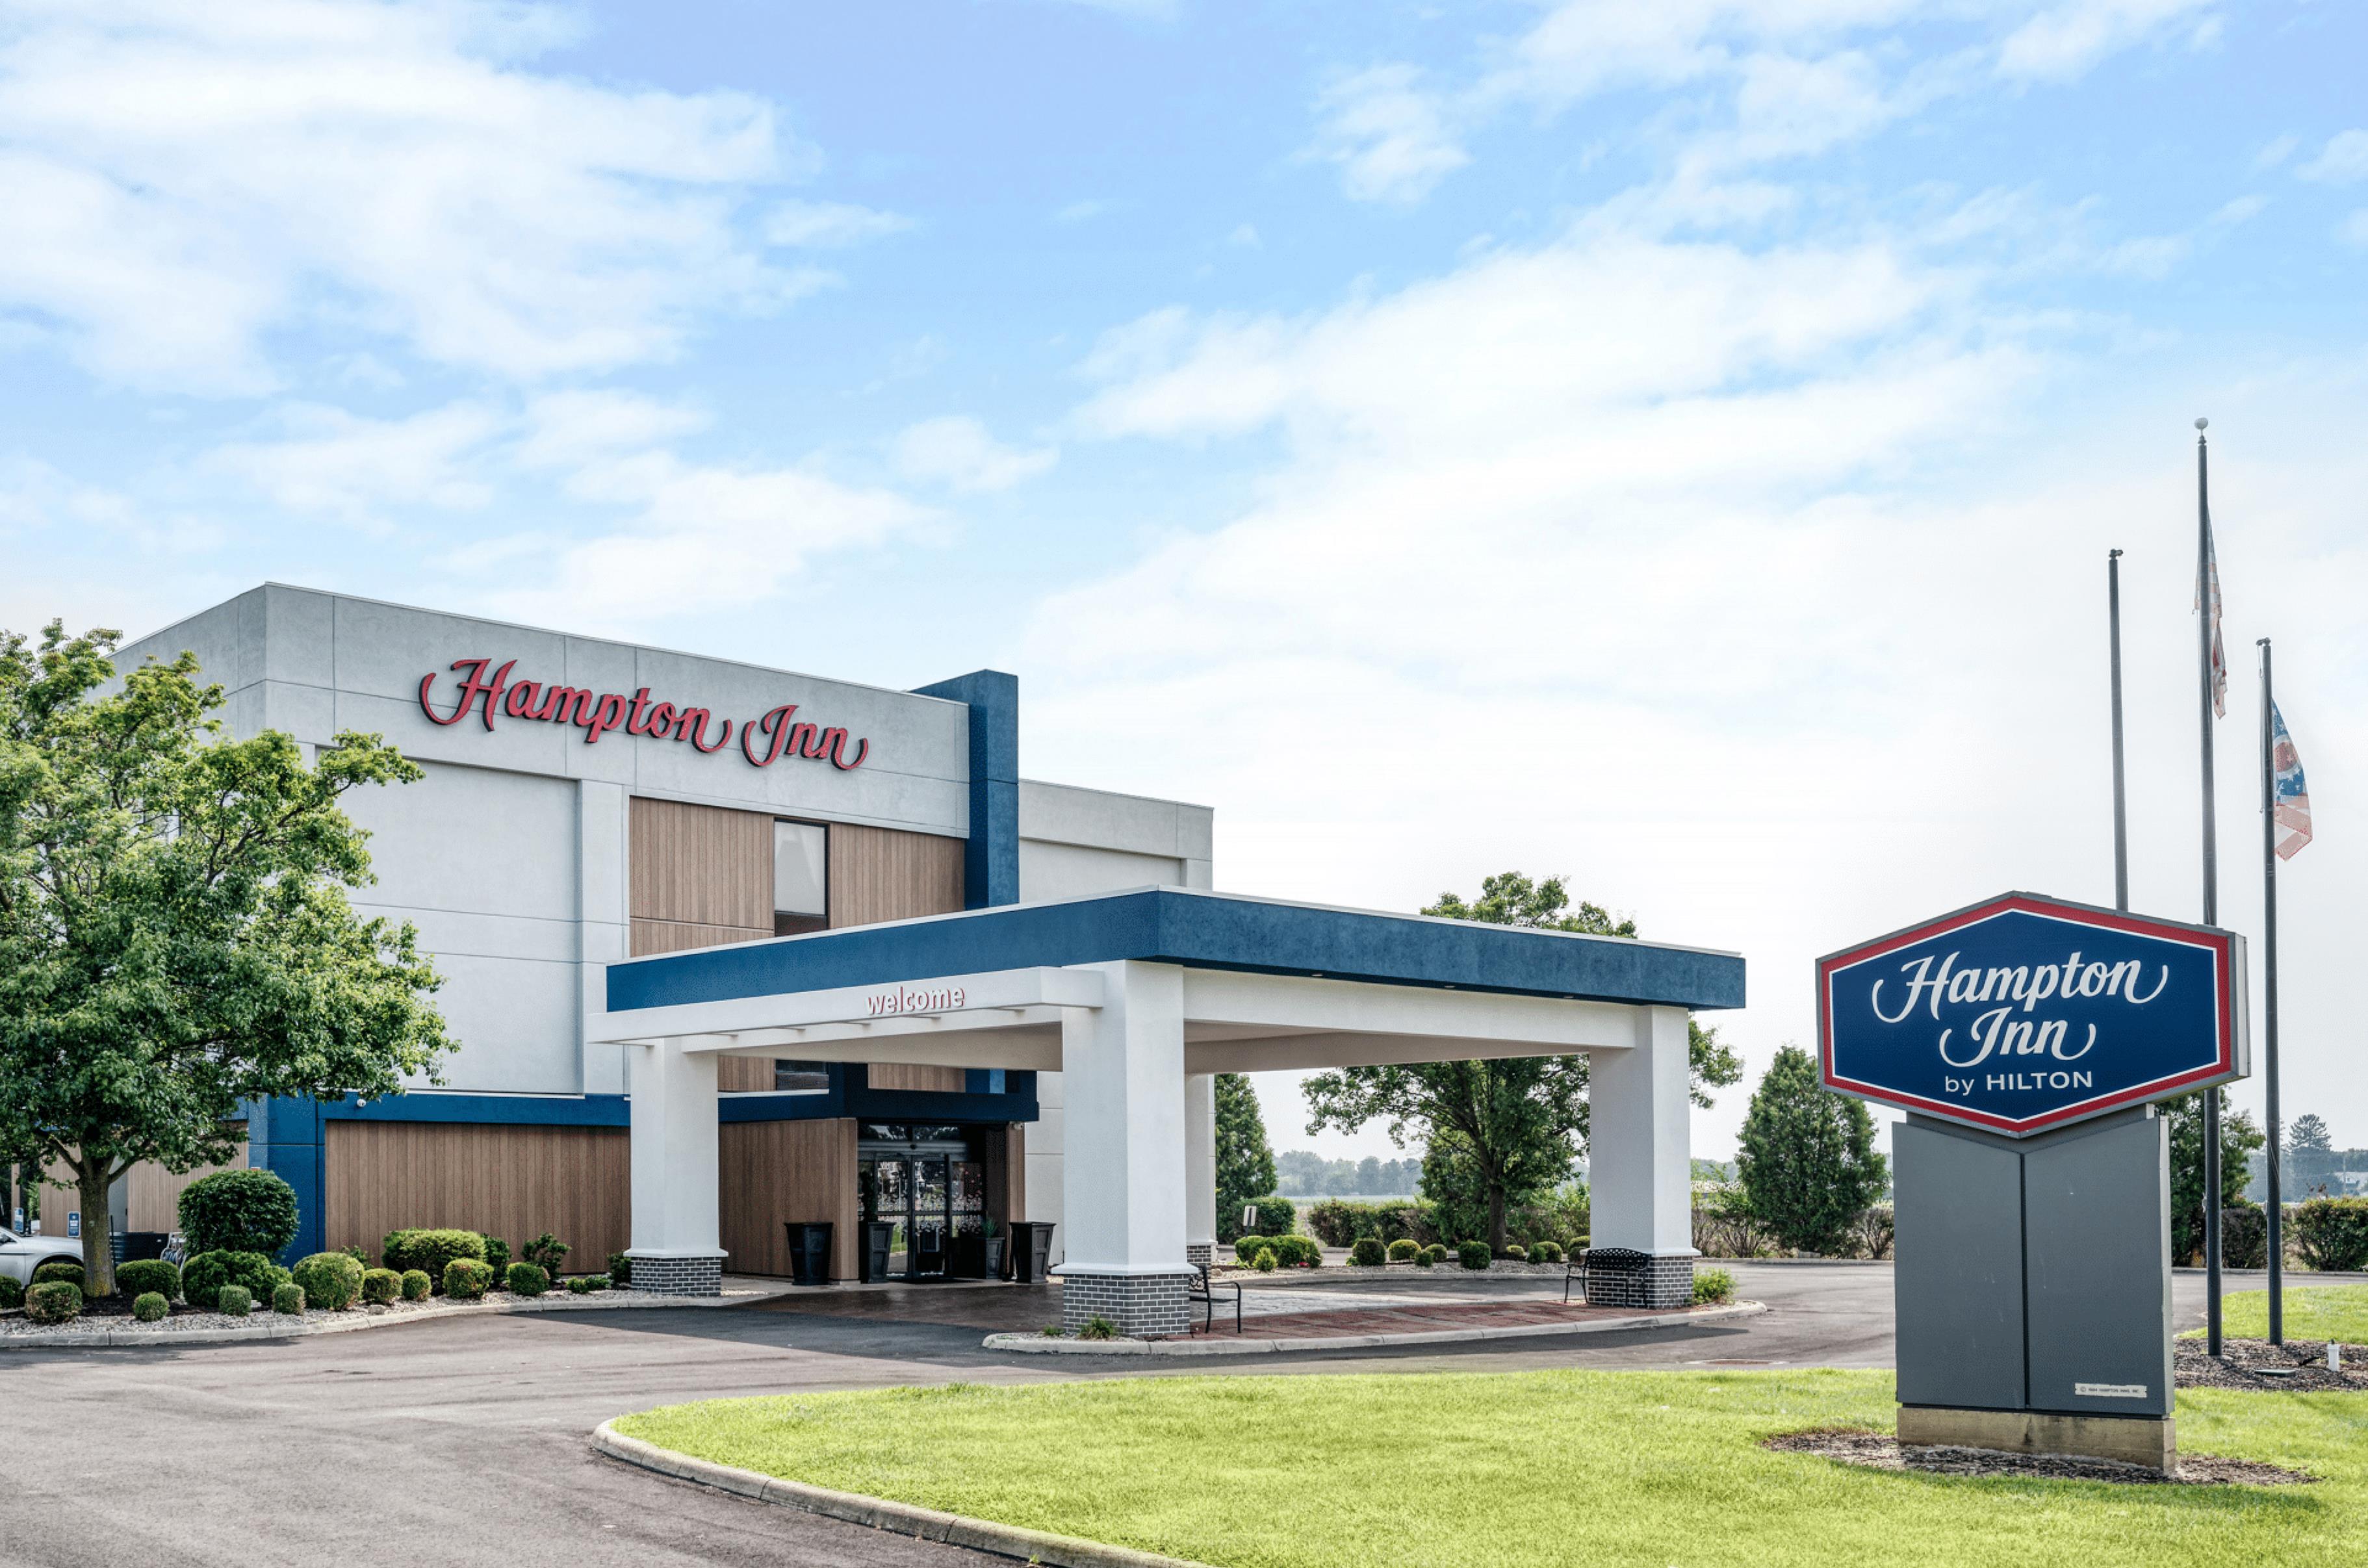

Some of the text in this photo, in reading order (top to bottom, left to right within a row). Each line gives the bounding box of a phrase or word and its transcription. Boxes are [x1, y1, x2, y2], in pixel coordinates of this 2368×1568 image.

[418, 658, 869, 771] Hampton Inn
[866, 986, 965, 1014] welcome
[1872, 951, 2169, 1023] Hampton
[1939, 1007, 2096, 1068] Inn
[1945, 1072, 2092, 1096] by HILTON
